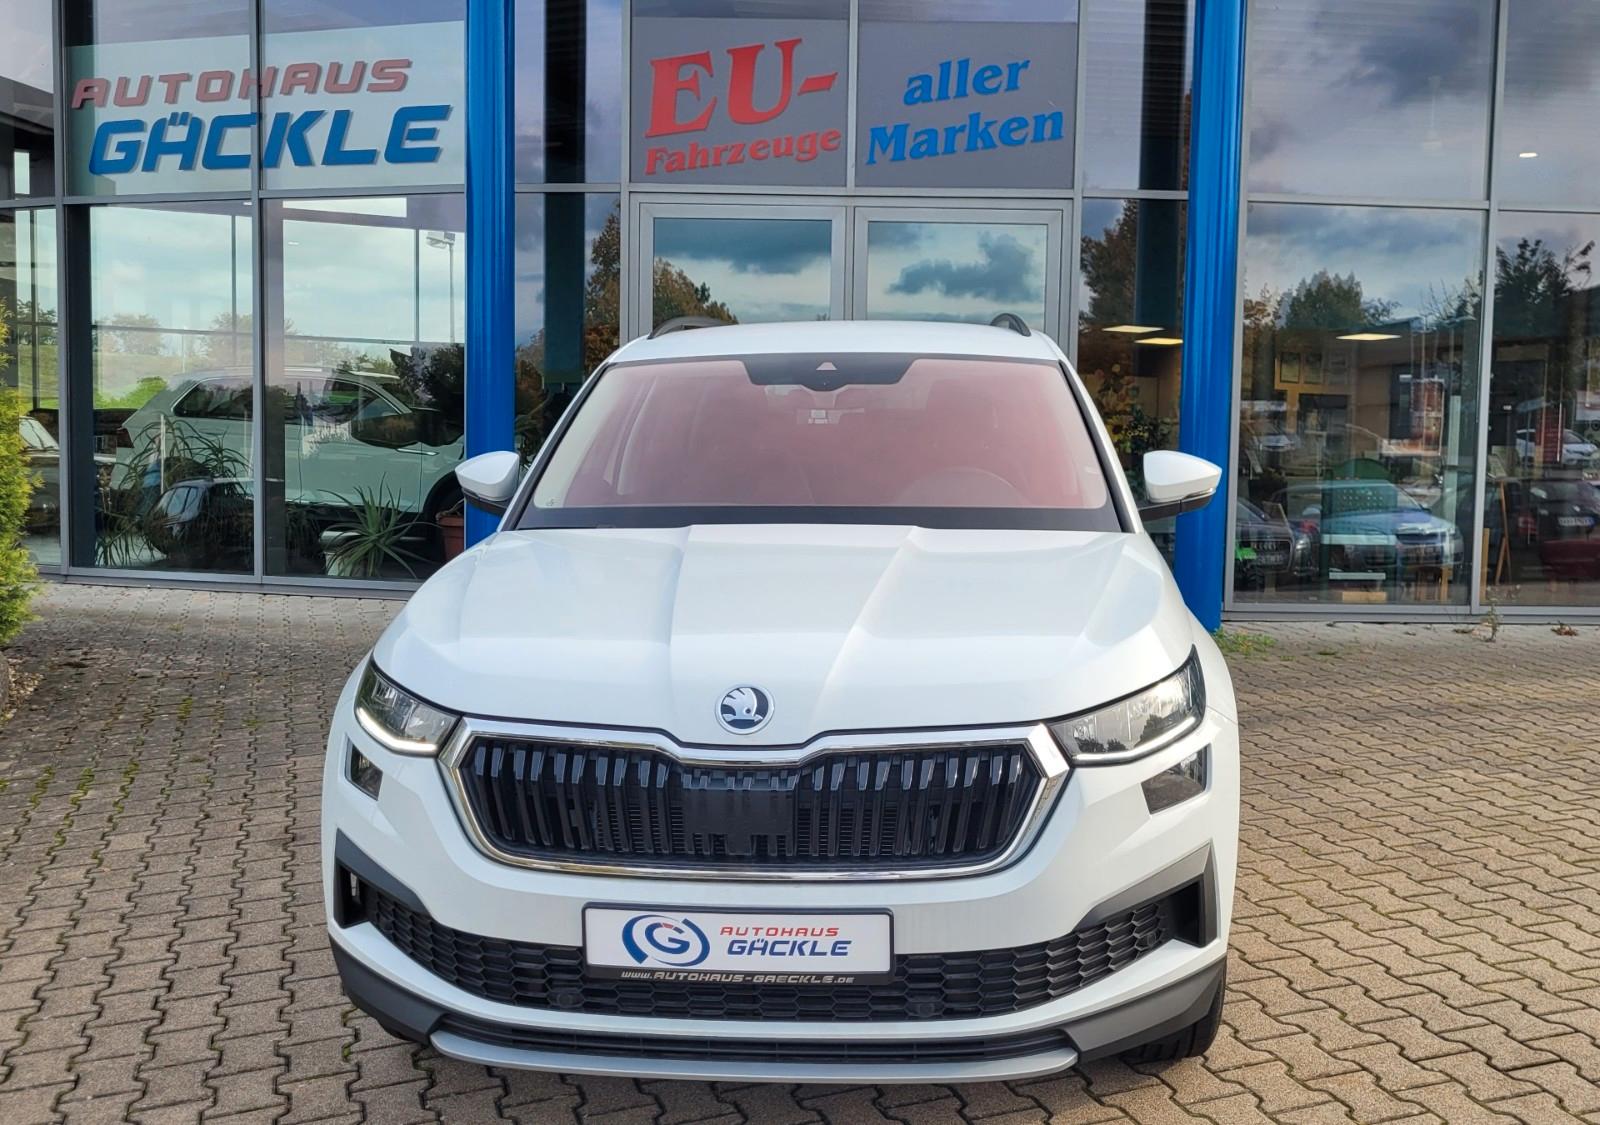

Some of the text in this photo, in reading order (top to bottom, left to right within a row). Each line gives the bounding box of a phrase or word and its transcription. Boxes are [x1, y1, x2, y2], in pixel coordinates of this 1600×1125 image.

[71, 58, 412, 109] AUTOHAUS
[645, 38, 838, 138] EU-
[904, 58, 1031, 106] aller
[89, 104, 452, 175] GÄCKLE
[644, 129, 841, 175] Fahrzeuge
[866, 110, 1064, 166] Marken
[719, 926, 840, 937] AUTOHAUS
[727, 938, 852, 957] GÄCKLE
